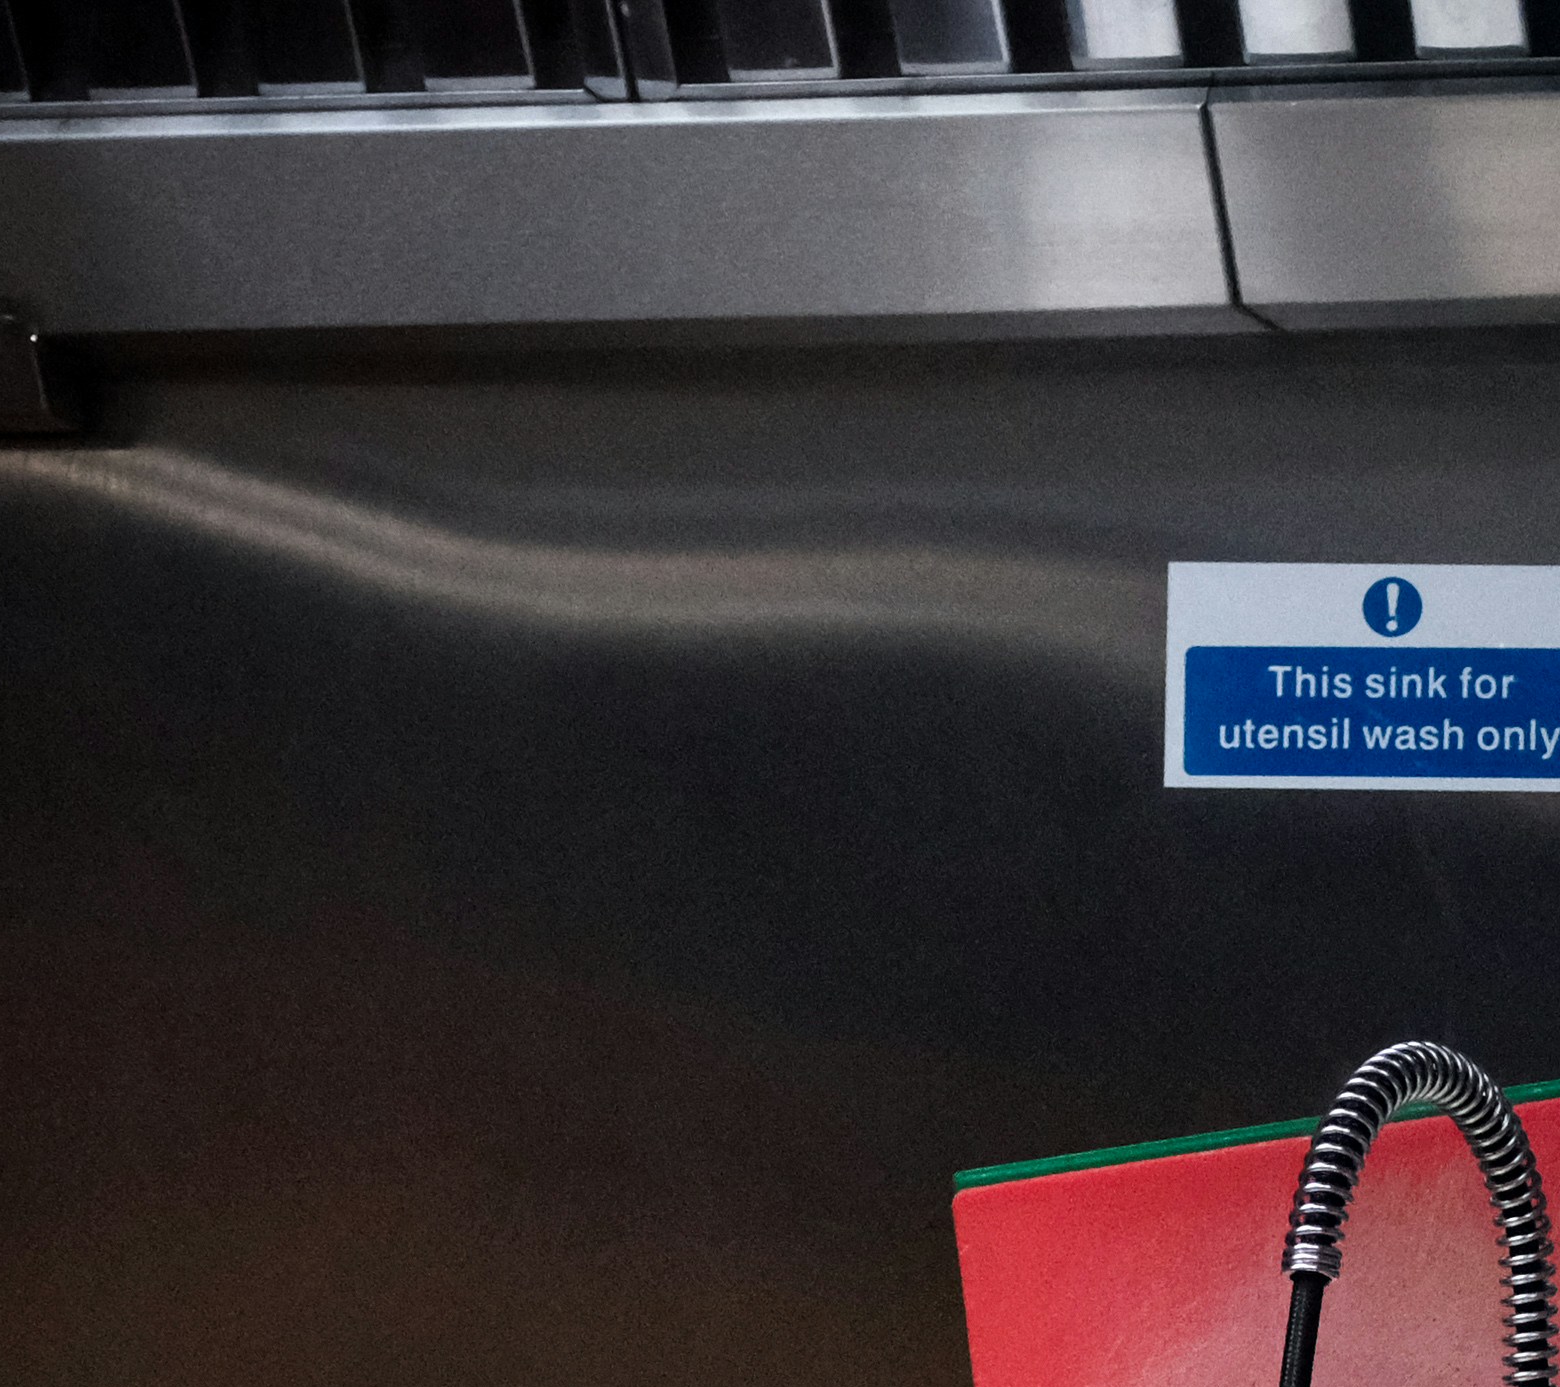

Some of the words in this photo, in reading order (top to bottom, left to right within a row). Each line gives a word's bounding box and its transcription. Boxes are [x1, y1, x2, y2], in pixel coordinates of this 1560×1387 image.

[1268, 665, 1352, 700] This
[1365, 666, 1447, 700] sink
[1459, 668, 1515, 700] for
[1218, 718, 1352, 751] utensil
[1364, 719, 1463, 751] wash
[1476, 720, 1560, 760] only
